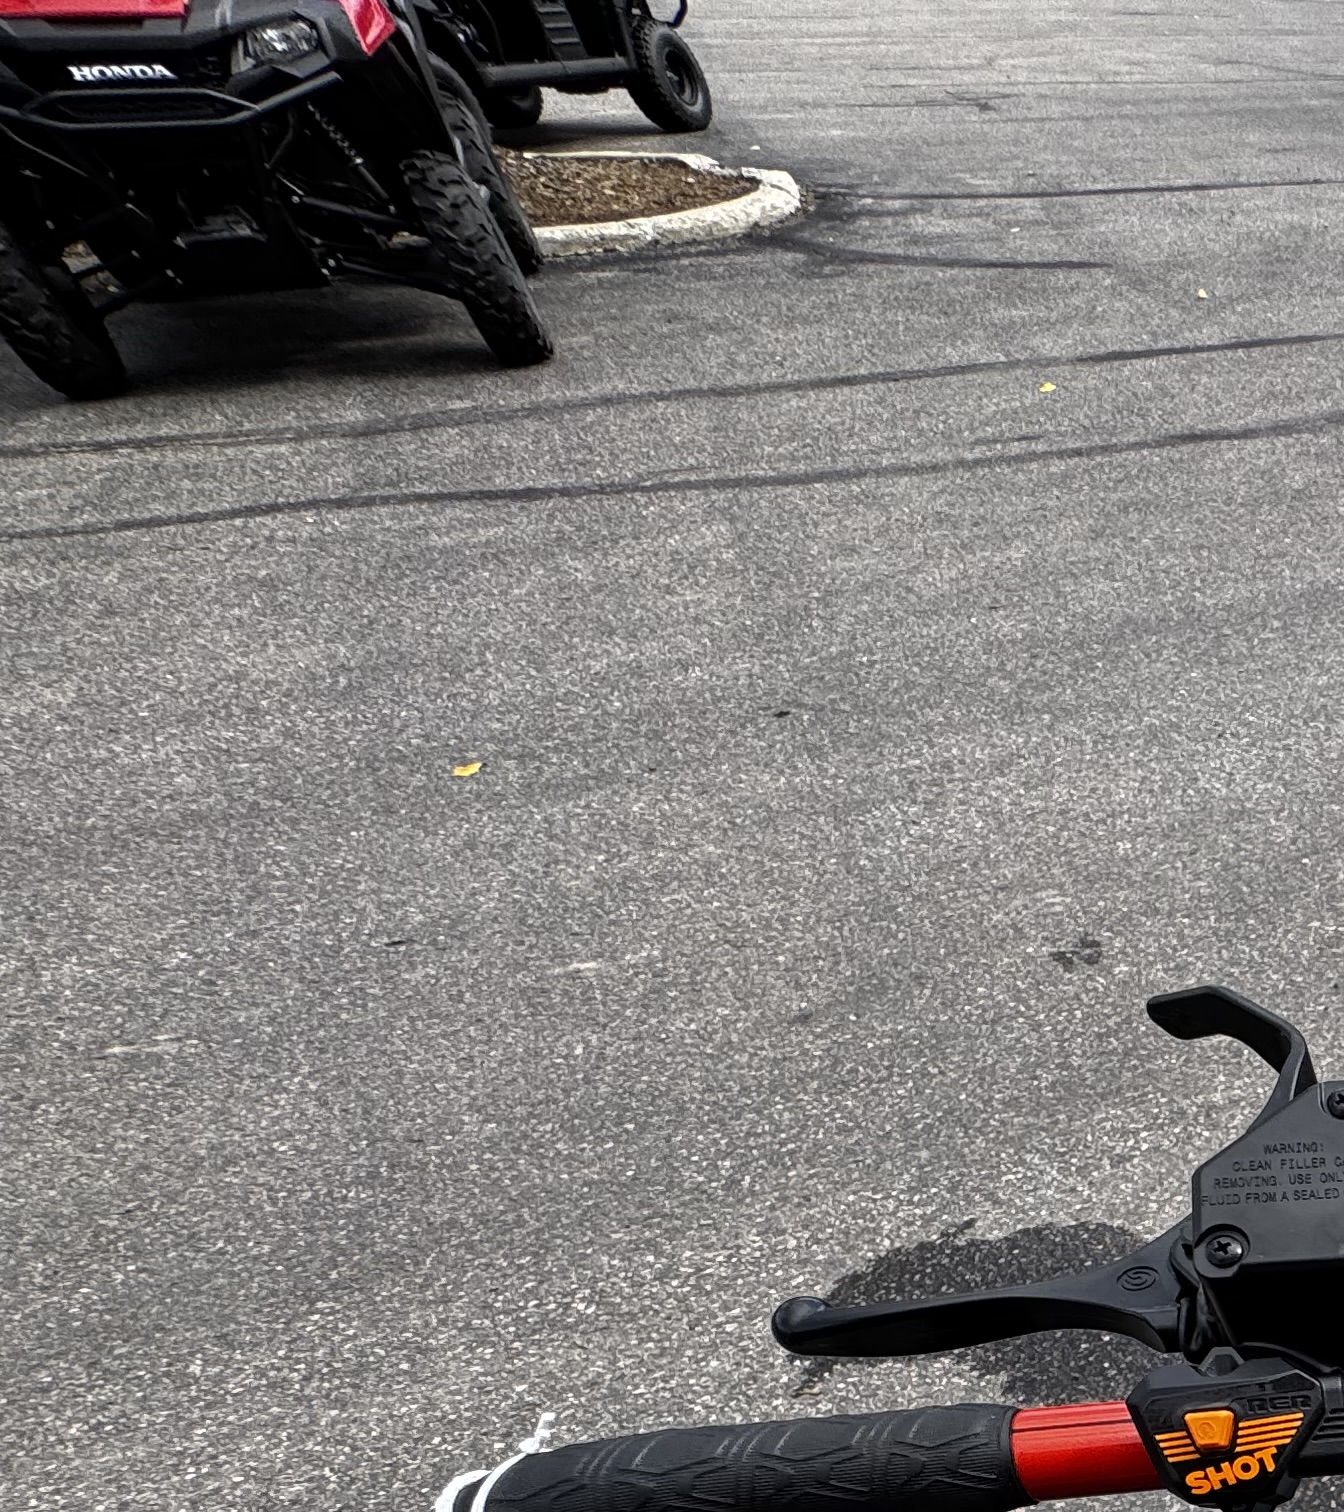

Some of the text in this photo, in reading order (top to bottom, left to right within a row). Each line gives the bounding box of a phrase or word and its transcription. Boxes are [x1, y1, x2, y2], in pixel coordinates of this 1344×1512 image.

[67, 65, 178, 81] HONDA
[1263, 1142, 1324, 1154] WARNING:
[1232, 1160, 1272, 1172] CLEAN
[1280, 1156, 1326, 1170] FILLER
[1288, 1173, 1312, 1185] USE
[1201, 1194, 1241, 1206] FLUID
[1246, 1191, 1277, 1204] FROM
[1281, 1190, 1289, 1203] A
[1294, 1187, 1340, 1201] SEALED
[1185, 1446, 1277, 1495] SHOT
